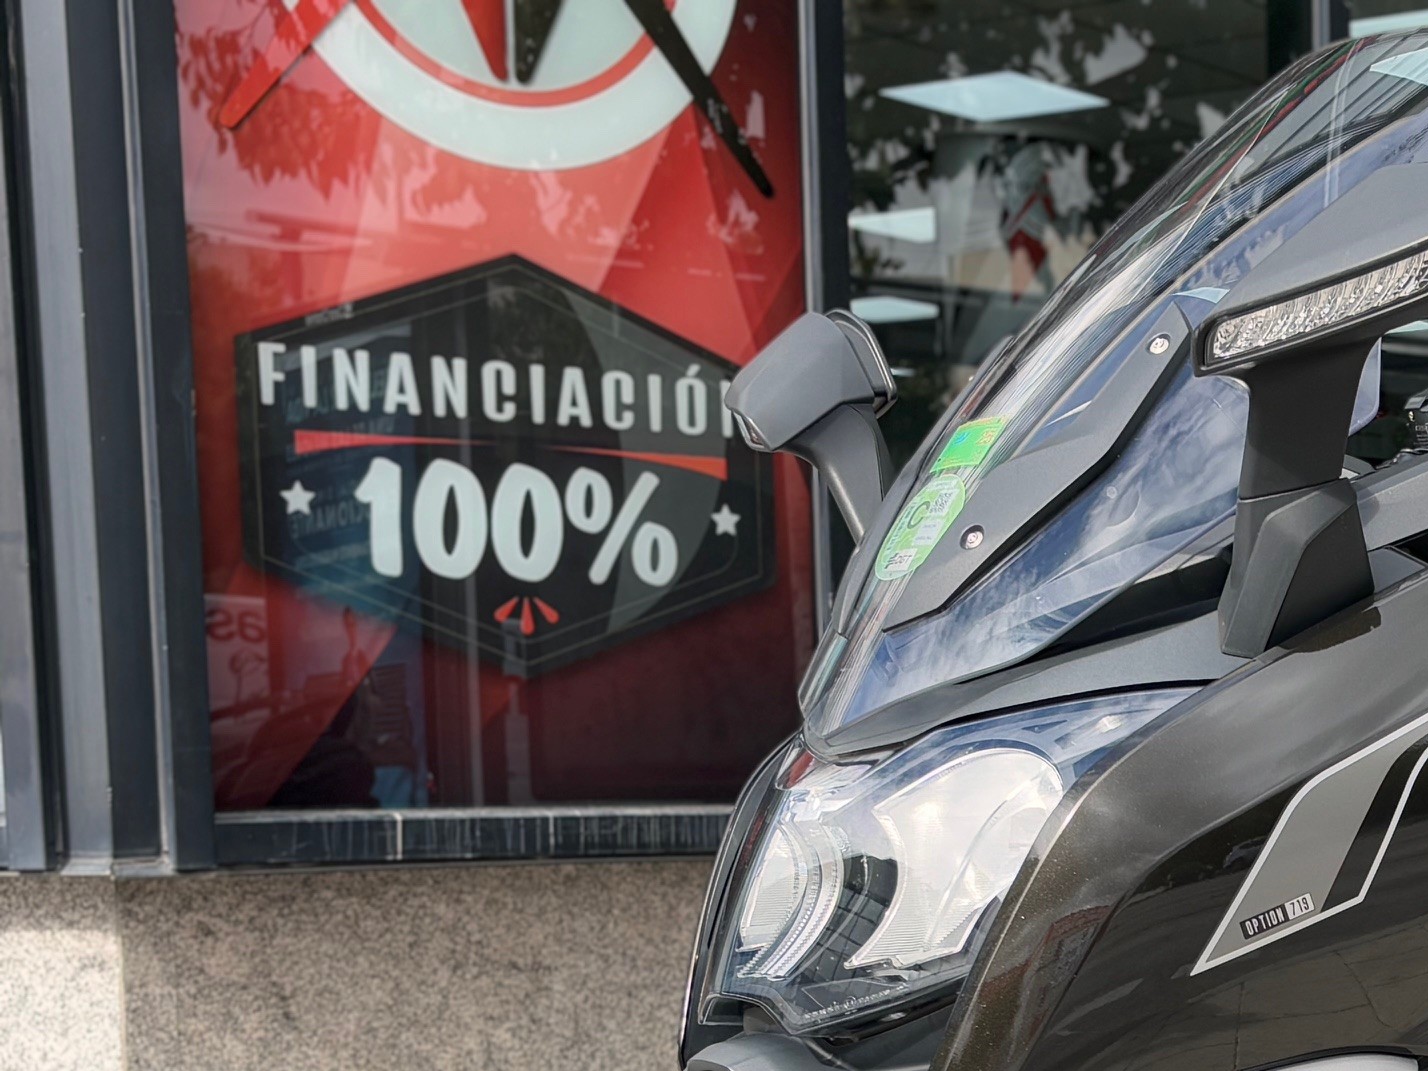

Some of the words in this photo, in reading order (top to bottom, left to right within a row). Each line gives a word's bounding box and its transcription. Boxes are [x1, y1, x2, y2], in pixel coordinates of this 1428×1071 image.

[355, 457, 679, 587] 100%
[1245, 907, 1286, 936] OPTION
[1289, 897, 1310, 917] 719
